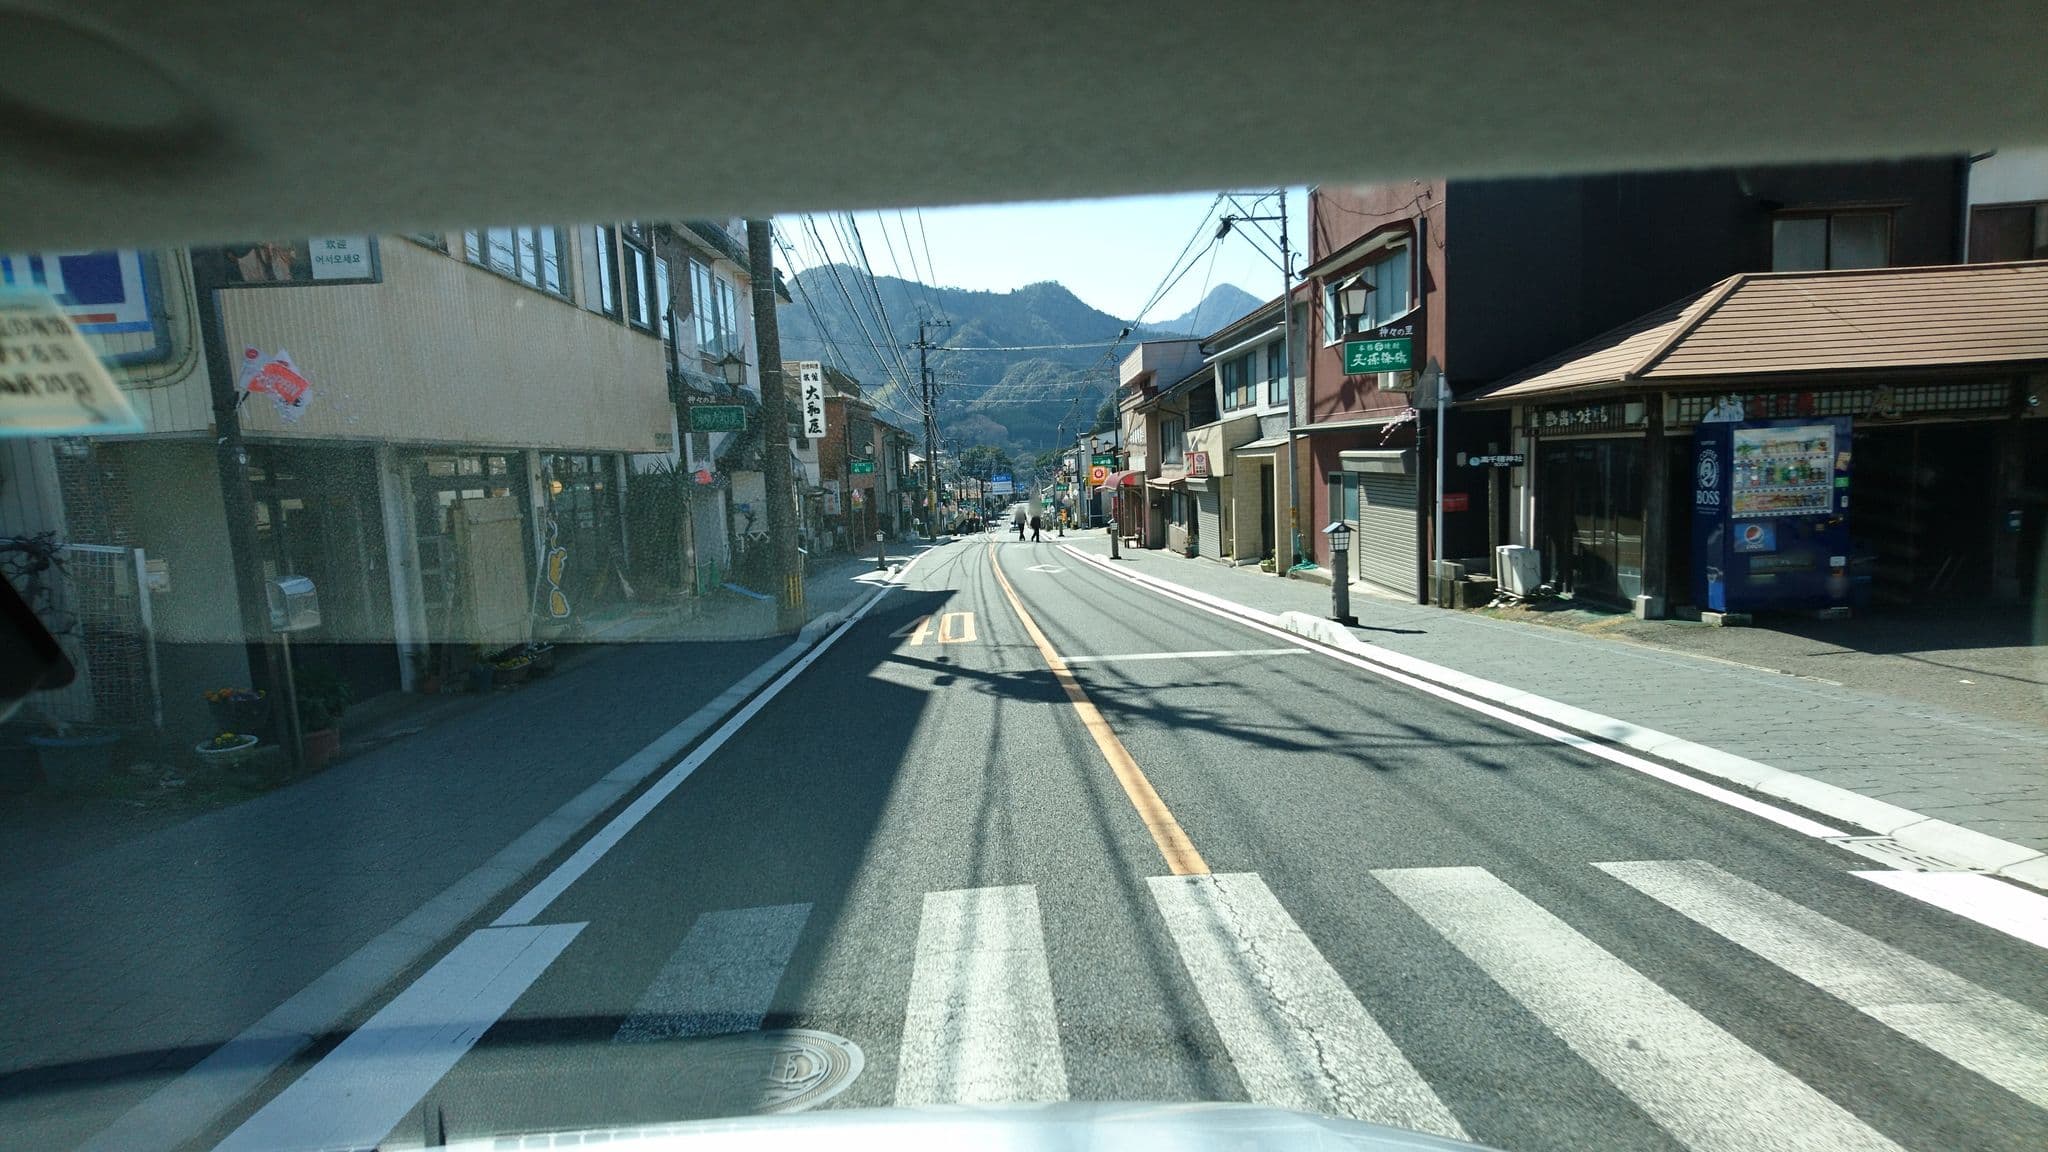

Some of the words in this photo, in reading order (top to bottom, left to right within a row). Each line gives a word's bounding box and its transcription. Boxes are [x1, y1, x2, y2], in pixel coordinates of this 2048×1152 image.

[315, 253, 361, 265] 어서오세요
[1379, 325, 1414, 338] 神々の里
[806, 384, 823, 434] 大和屋
[1696, 490, 1721, 505] BOSS
[889, 611, 978, 647] 40
